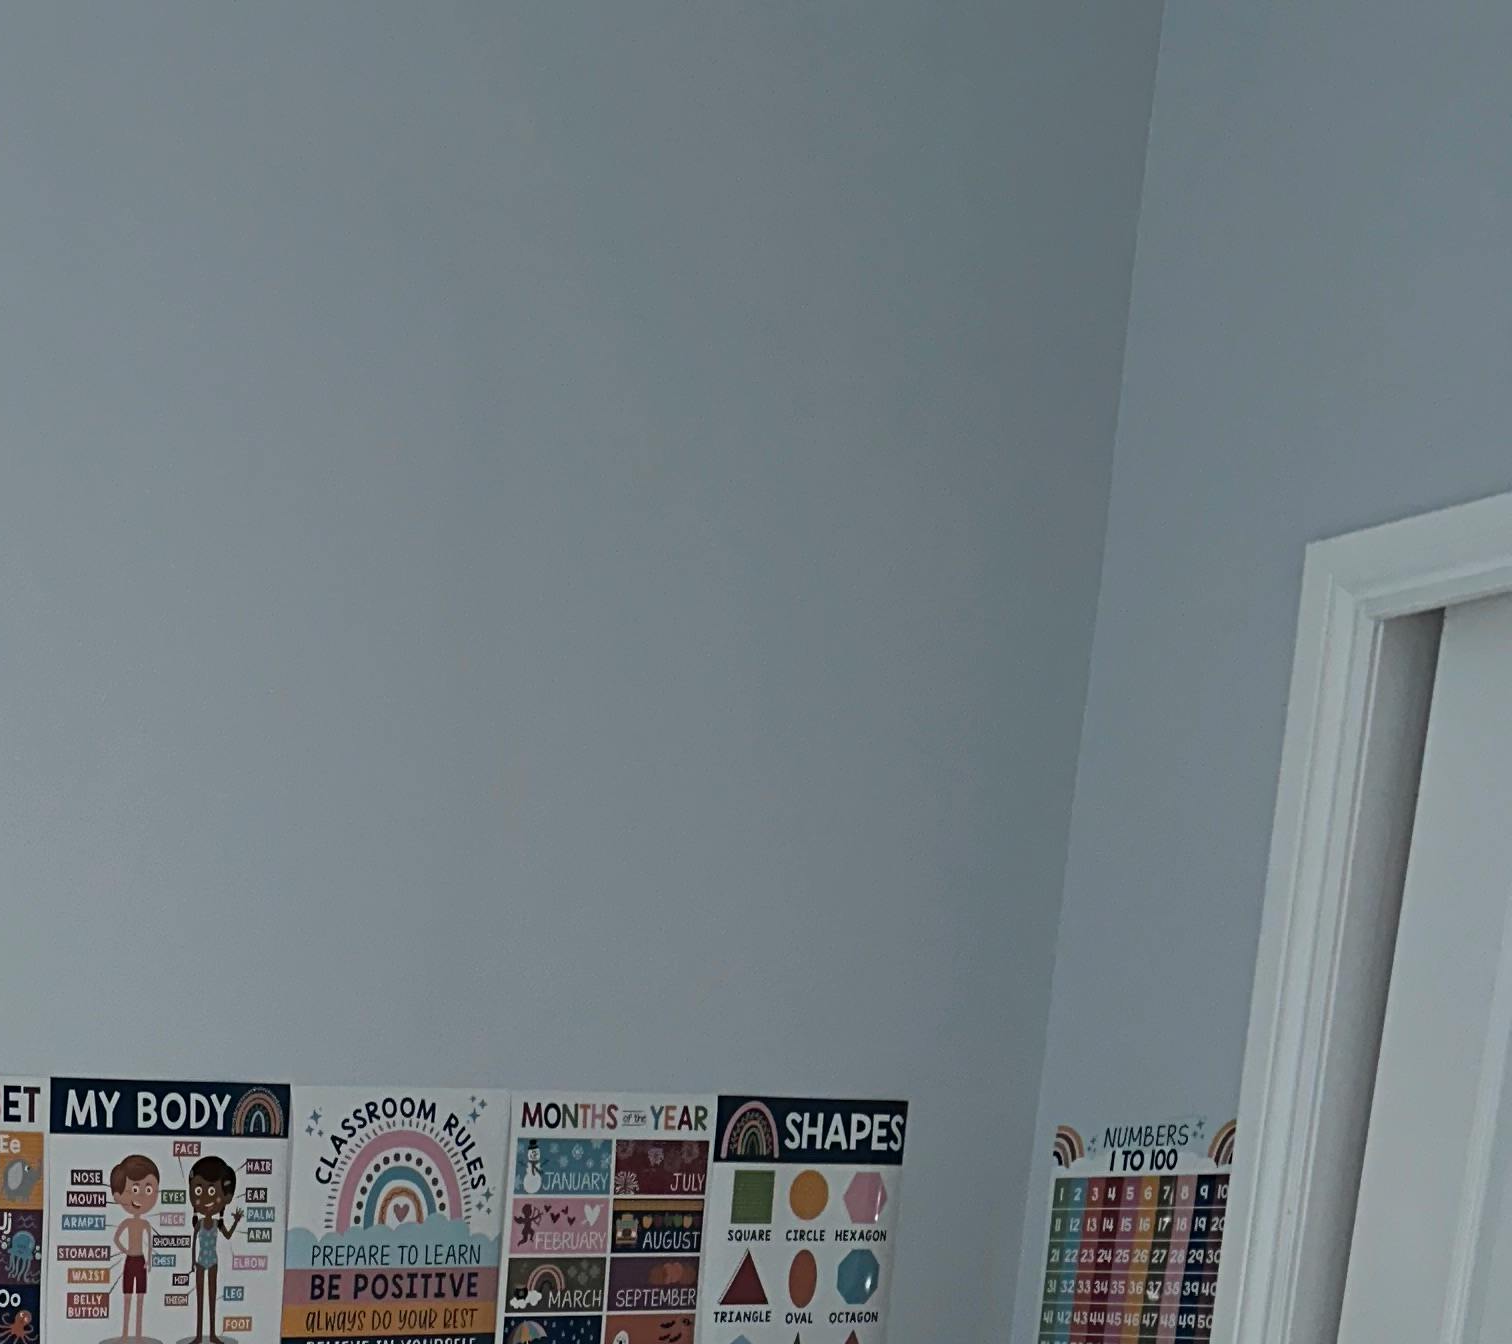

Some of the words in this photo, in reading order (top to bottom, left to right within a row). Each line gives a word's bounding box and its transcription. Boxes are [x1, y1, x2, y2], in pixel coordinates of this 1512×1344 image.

[65, 1089, 120, 1128] MY
[137, 1091, 231, 1131] BODY
[521, 1102, 618, 1130] MONTHS
[650, 1105, 708, 1131] YEAR
[784, 1112, 905, 1151] SHAPES
[1104, 1125, 1189, 1148] NUMBERS
[316, 1097, 436, 1184] CLASSROOM
[443, 1113, 486, 1190] RULES
[1122, 1150, 1144, 1171] TO
[1150, 1149, 1178, 1170] 100
[73, 1172, 101, 1183] NOSE
[68, 1193, 105, 1205] MOUTH
[643, 1232, 700, 1249] AUGUST
[728, 1230, 771, 1242] SQUARE
[785, 1230, 825, 1241] CIRCLE
[835, 1230, 887, 1241] HEXAGON
[58, 1248, 109, 1259] STOMACH
[311, 1245, 390, 1266] PREPARE
[398, 1245, 418, 1265] TO
[425, 1245, 481, 1265] LEARN
[311, 1274, 341, 1300] BE
[354, 1272, 479, 1299] POSITIVE
